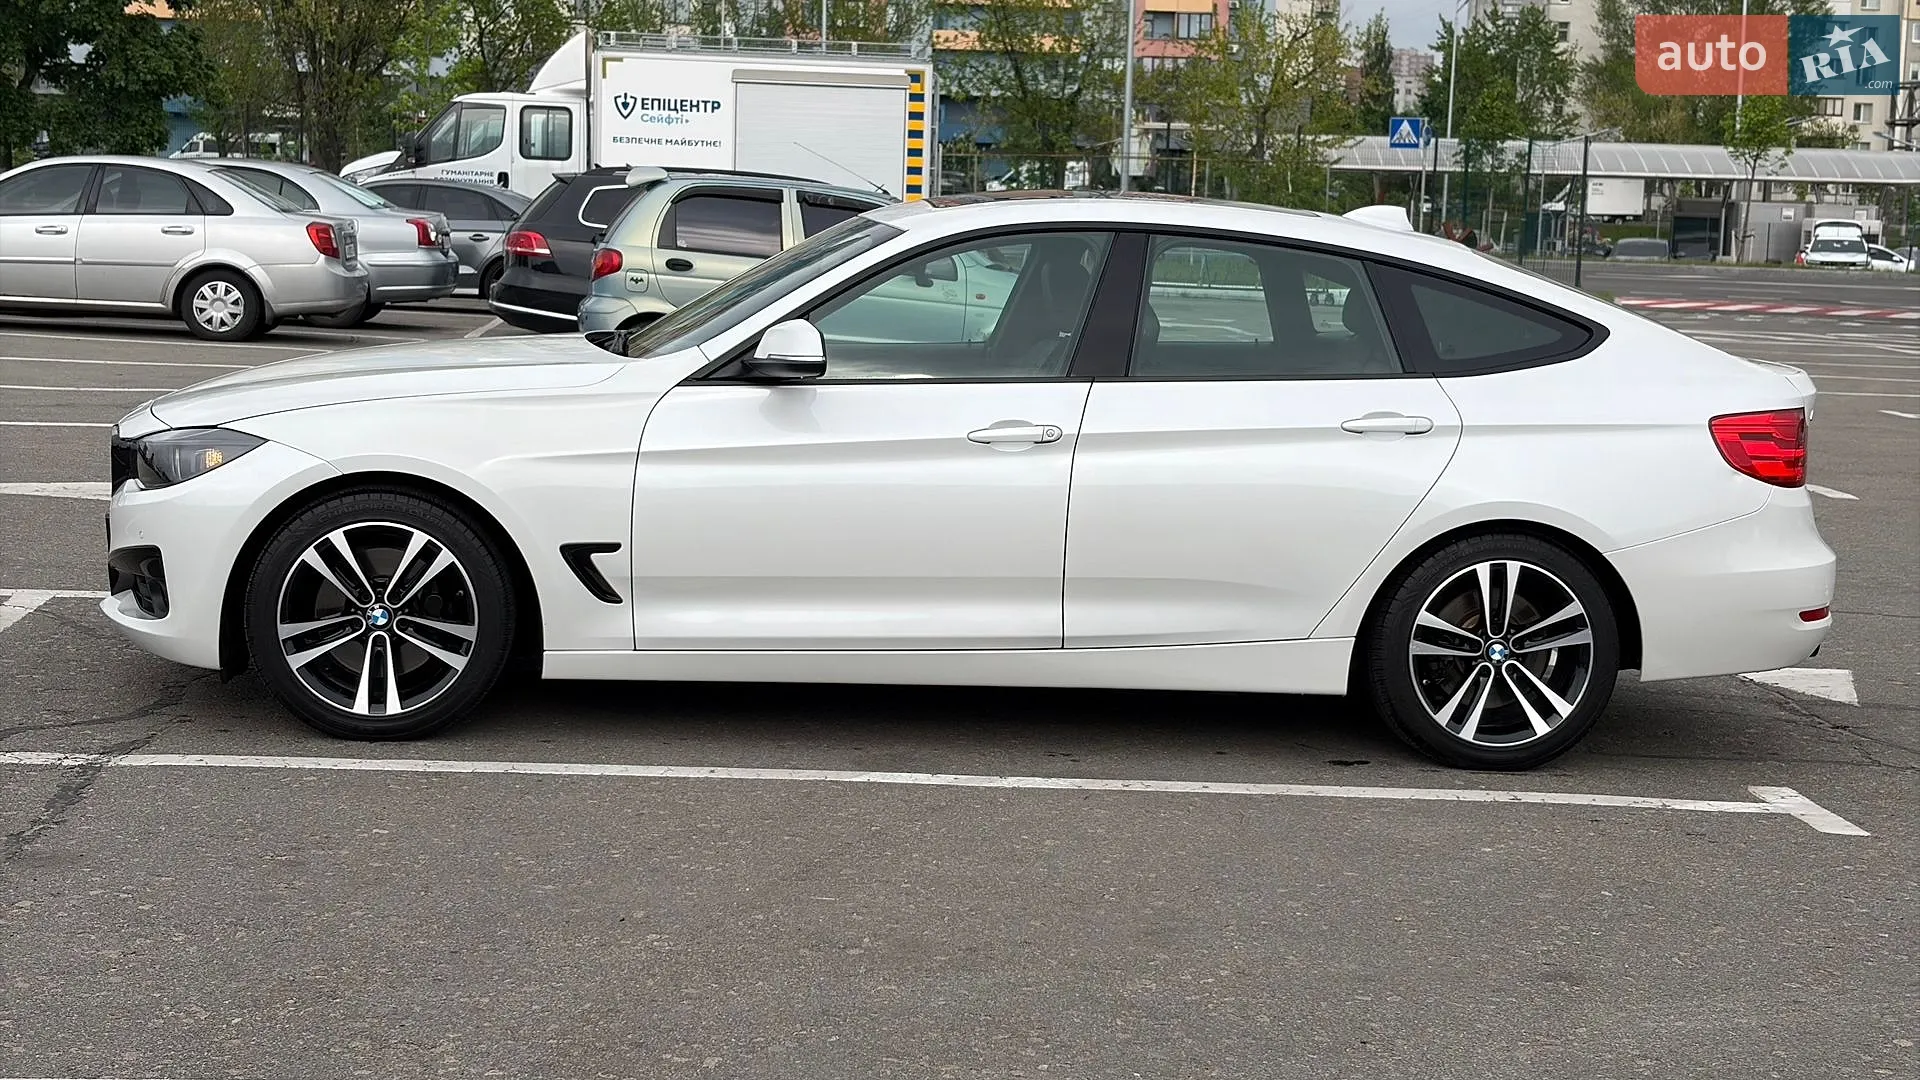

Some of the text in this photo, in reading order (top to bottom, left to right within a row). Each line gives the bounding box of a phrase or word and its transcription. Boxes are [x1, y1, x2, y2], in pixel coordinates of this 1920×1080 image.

[641, 97, 721, 114] ЕПІЦЕНТР
[640, 113, 684, 126] Сейфті
[612, 136, 722, 148] БЕЗПЕЧНЕ МАЙБУТНЄ!
[441, 169, 495, 178] ГУМАНІТАРНЕ
